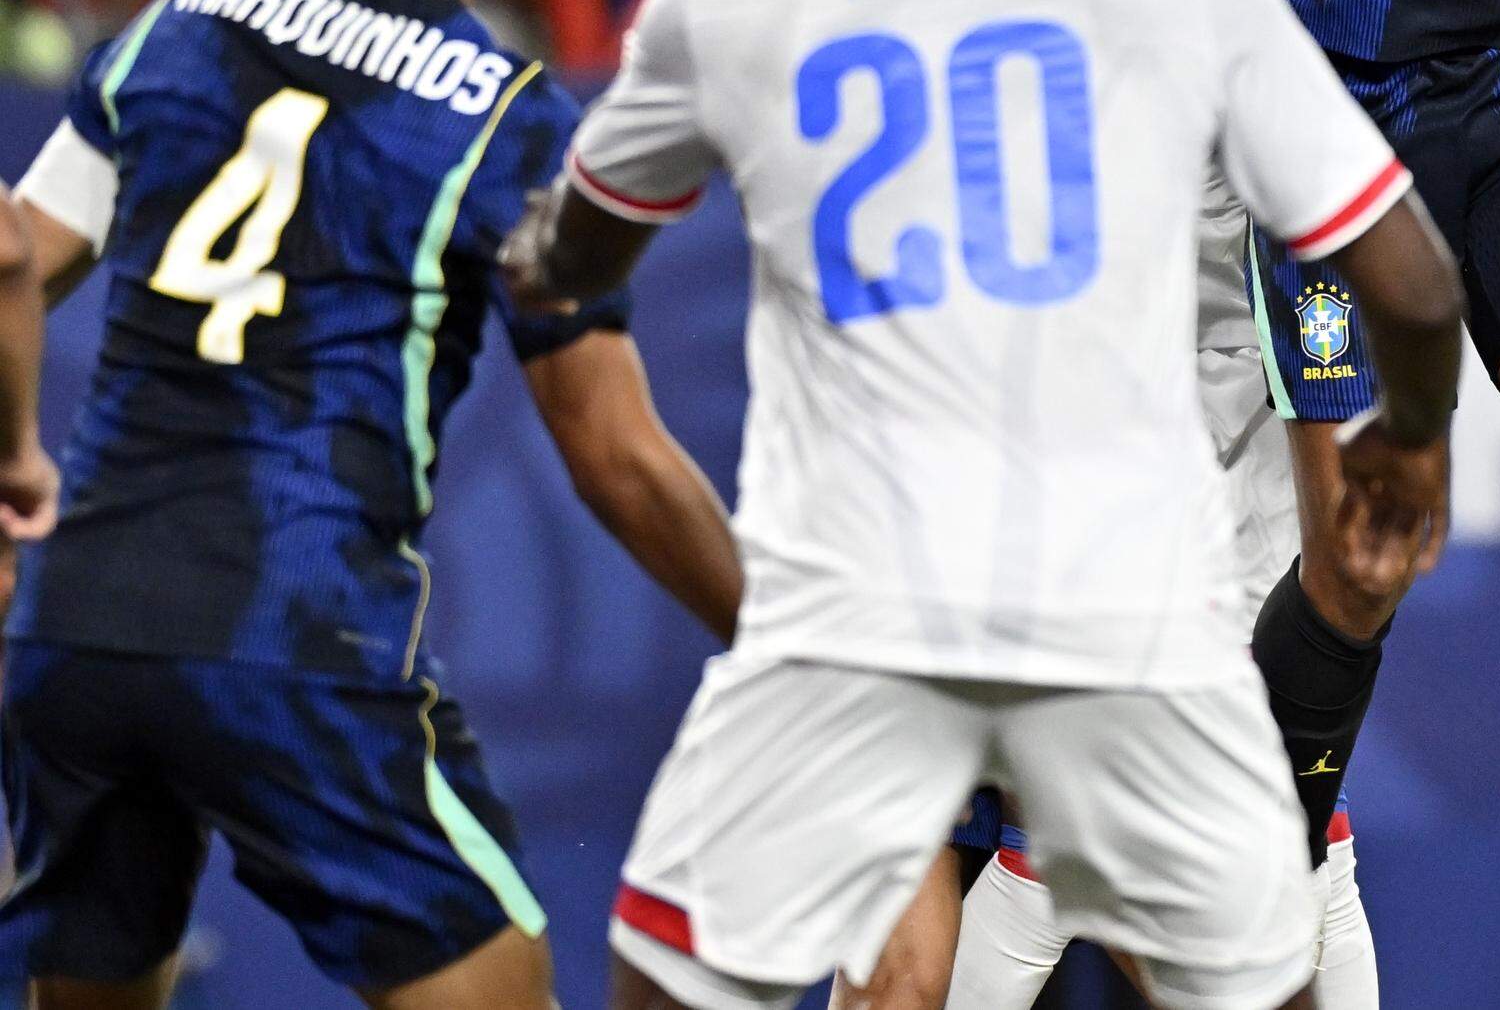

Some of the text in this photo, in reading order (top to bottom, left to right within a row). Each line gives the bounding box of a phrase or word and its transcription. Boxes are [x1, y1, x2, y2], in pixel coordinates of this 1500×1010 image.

[149, 86, 330, 366] 4
[793, 18, 1103, 326] 20
[1302, 364, 1358, 380] BRASIL
[1313, 322, 1333, 331] CBF
